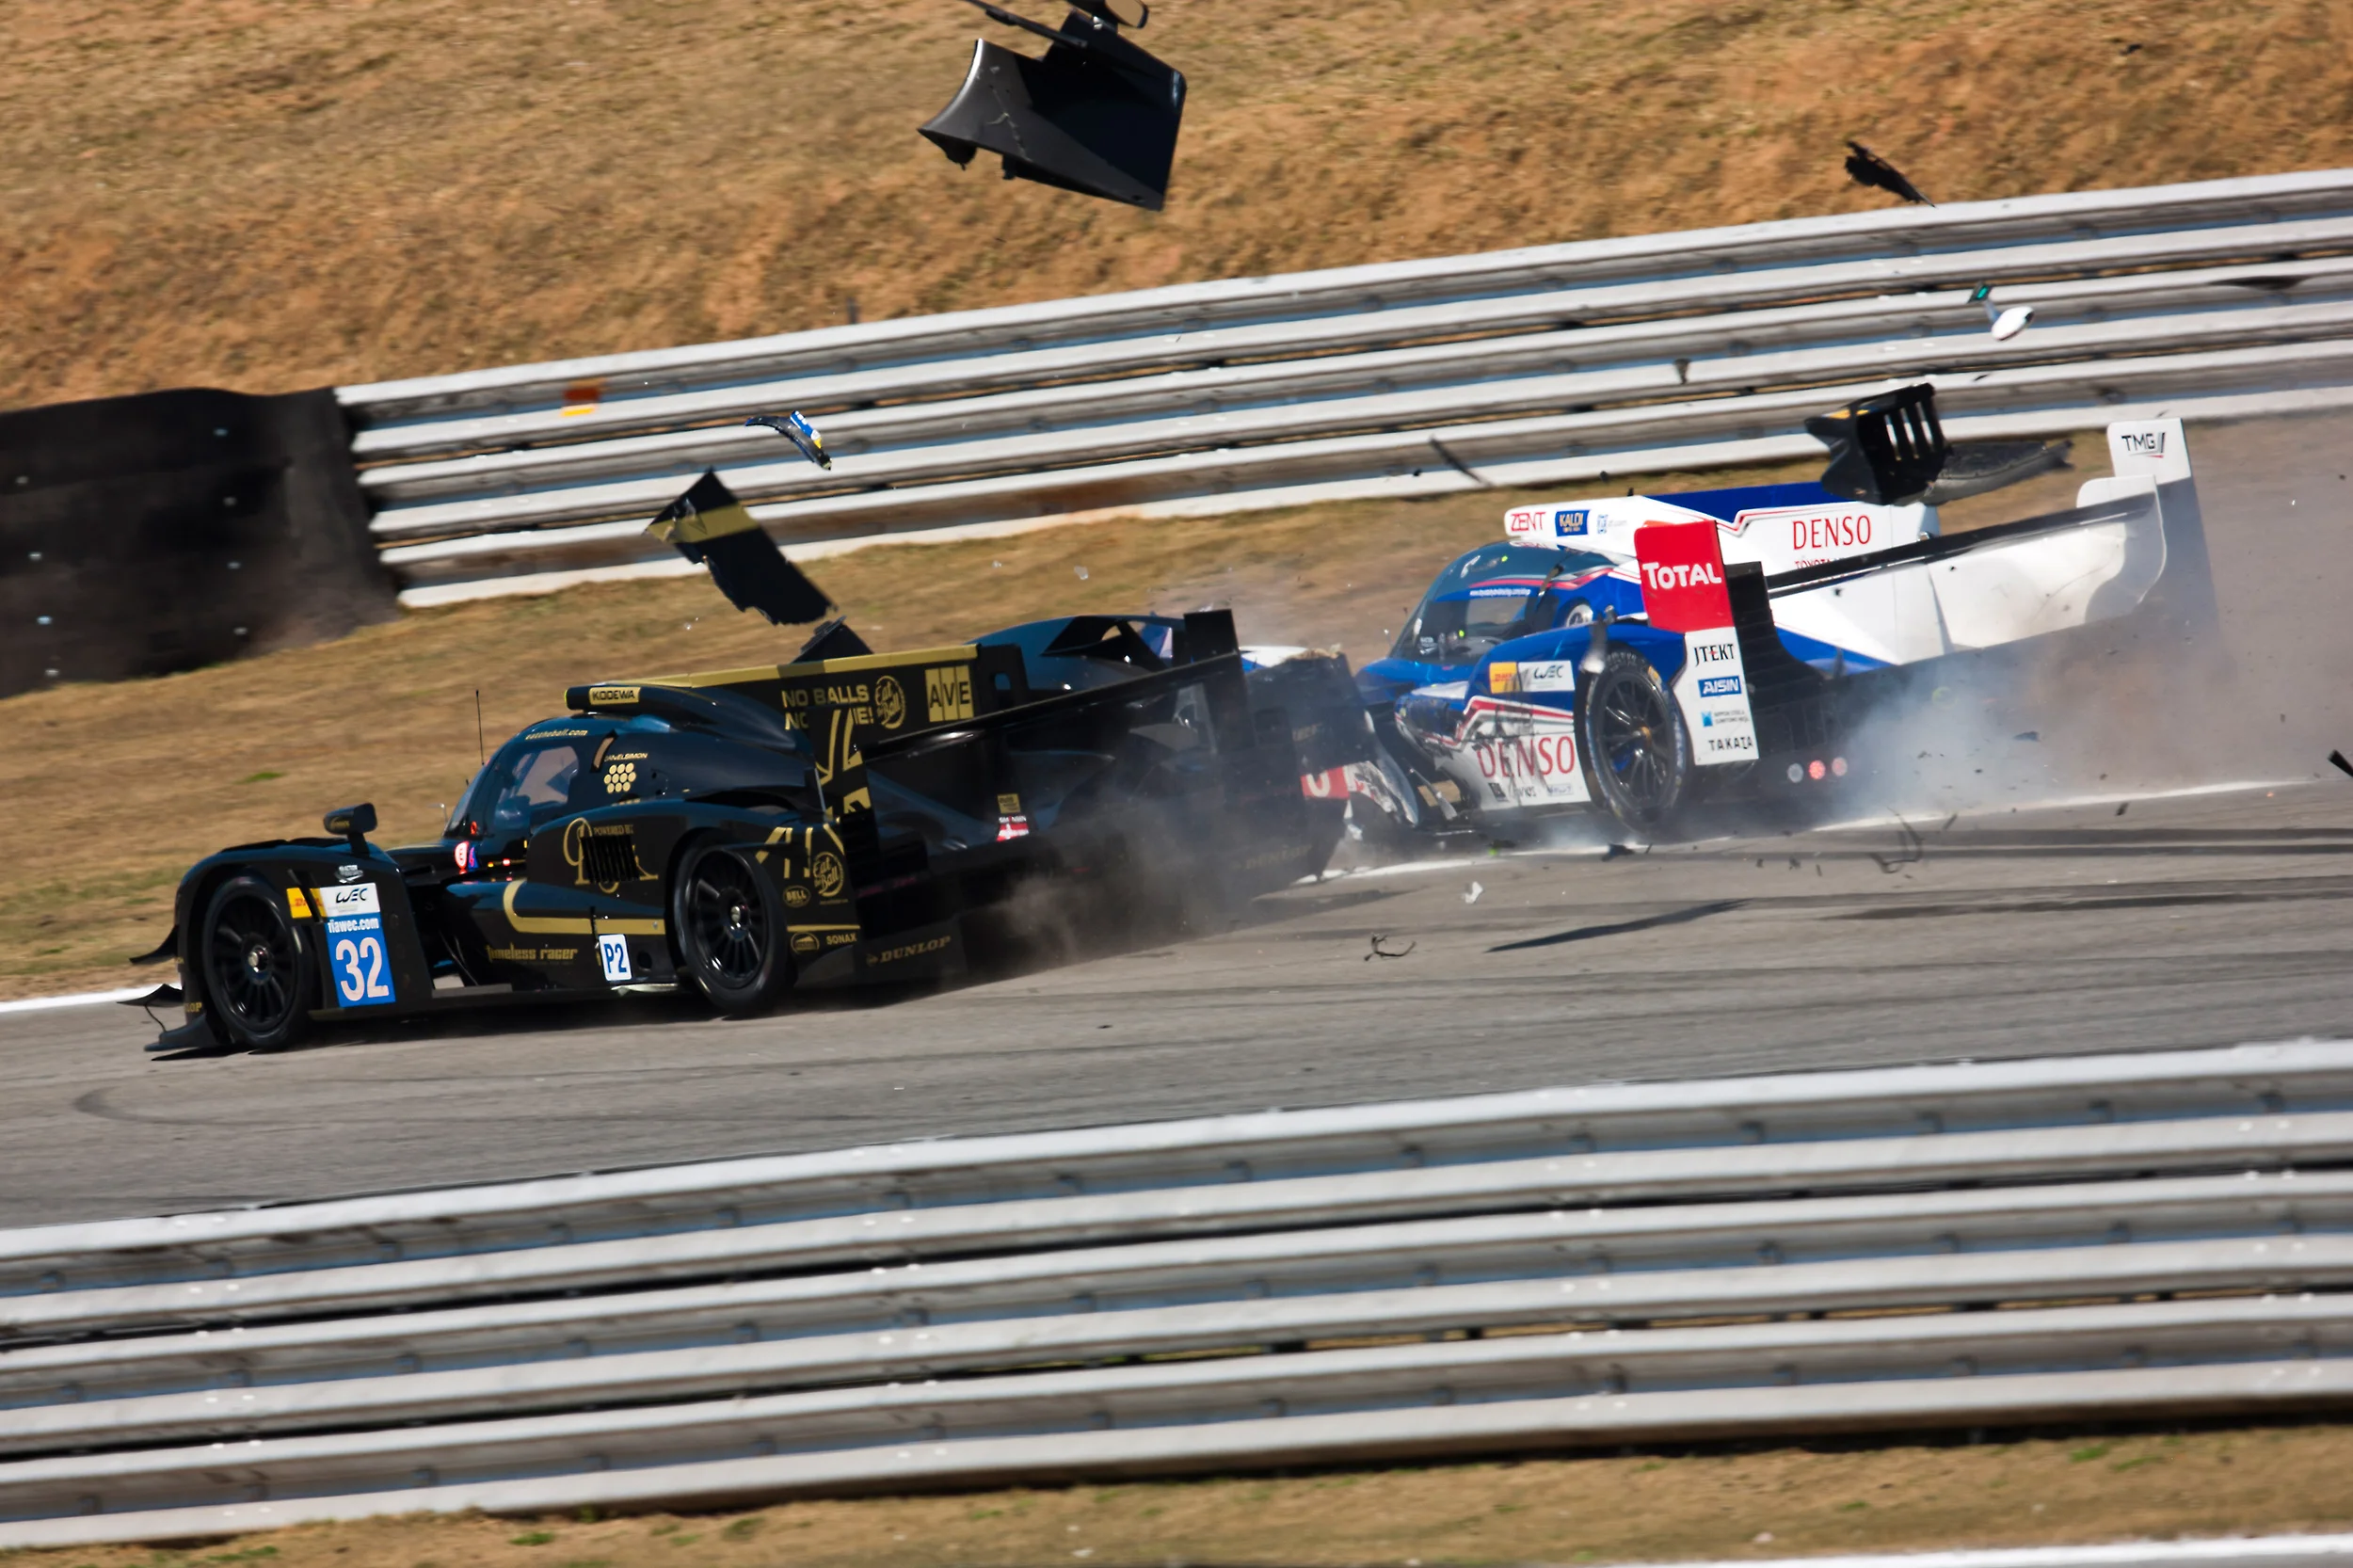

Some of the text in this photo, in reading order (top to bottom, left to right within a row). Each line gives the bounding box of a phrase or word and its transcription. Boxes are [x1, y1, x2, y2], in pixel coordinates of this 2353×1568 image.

[1511, 511, 1546, 532] ZENT
[1559, 512, 1584, 527] KALDI
[1792, 515, 1871, 550] DENSO
[1641, 562, 1722, 590] TOTAL
[1694, 644, 1735, 666] JTEKT
[1534, 665, 1564, 680] WEC
[593, 690, 635, 700] KODEWA
[781, 684, 870, 708] NO BALLS
[929, 681, 971, 708] AVE
[1703, 679, 1739, 694] AISIN
[1708, 737, 1753, 751] TAKATA
[1475, 736, 1576, 779] DENSO
[336, 888, 367, 904] WEC
[786, 890, 807, 902] BELL
[826, 934, 857, 945] SONAX
[880, 936, 951, 963] DUNLOP
[539, 949, 578, 960] racer
[603, 943, 627, 974] P2
[336, 937, 389, 1001] 32
